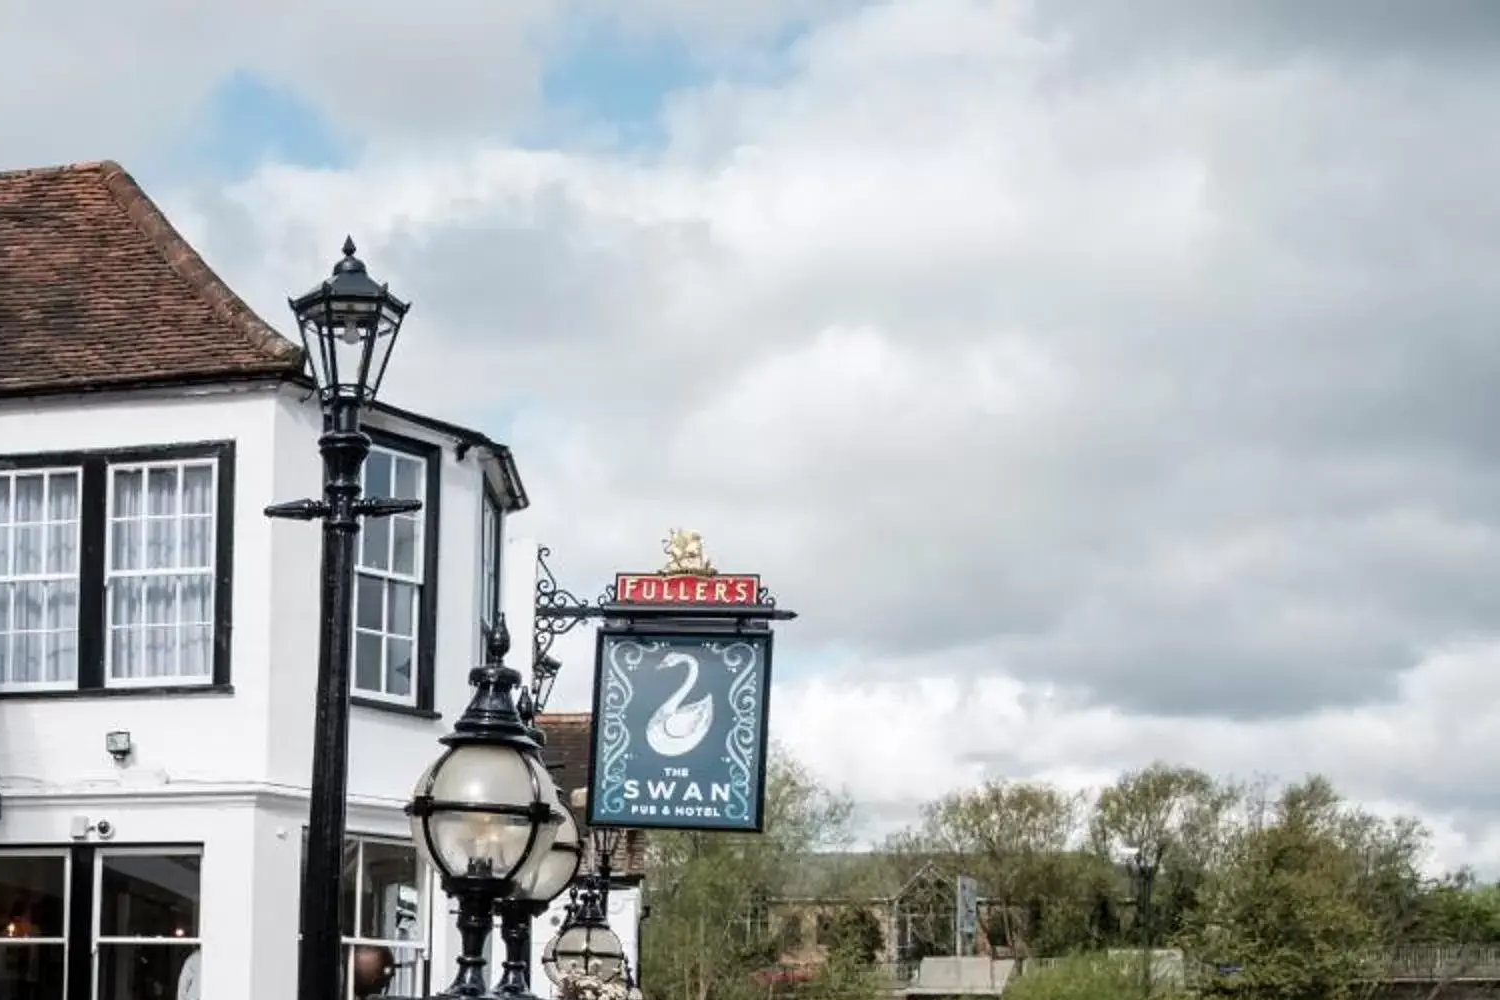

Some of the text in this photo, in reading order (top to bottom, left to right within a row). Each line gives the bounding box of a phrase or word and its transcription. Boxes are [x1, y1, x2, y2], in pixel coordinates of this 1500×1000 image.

[625, 578, 747, 603] FULLER'S
[663, 766, 689, 778] THE
[623, 779, 731, 802] SWAN
[631, 804, 720, 817] PUB & HOTEL
